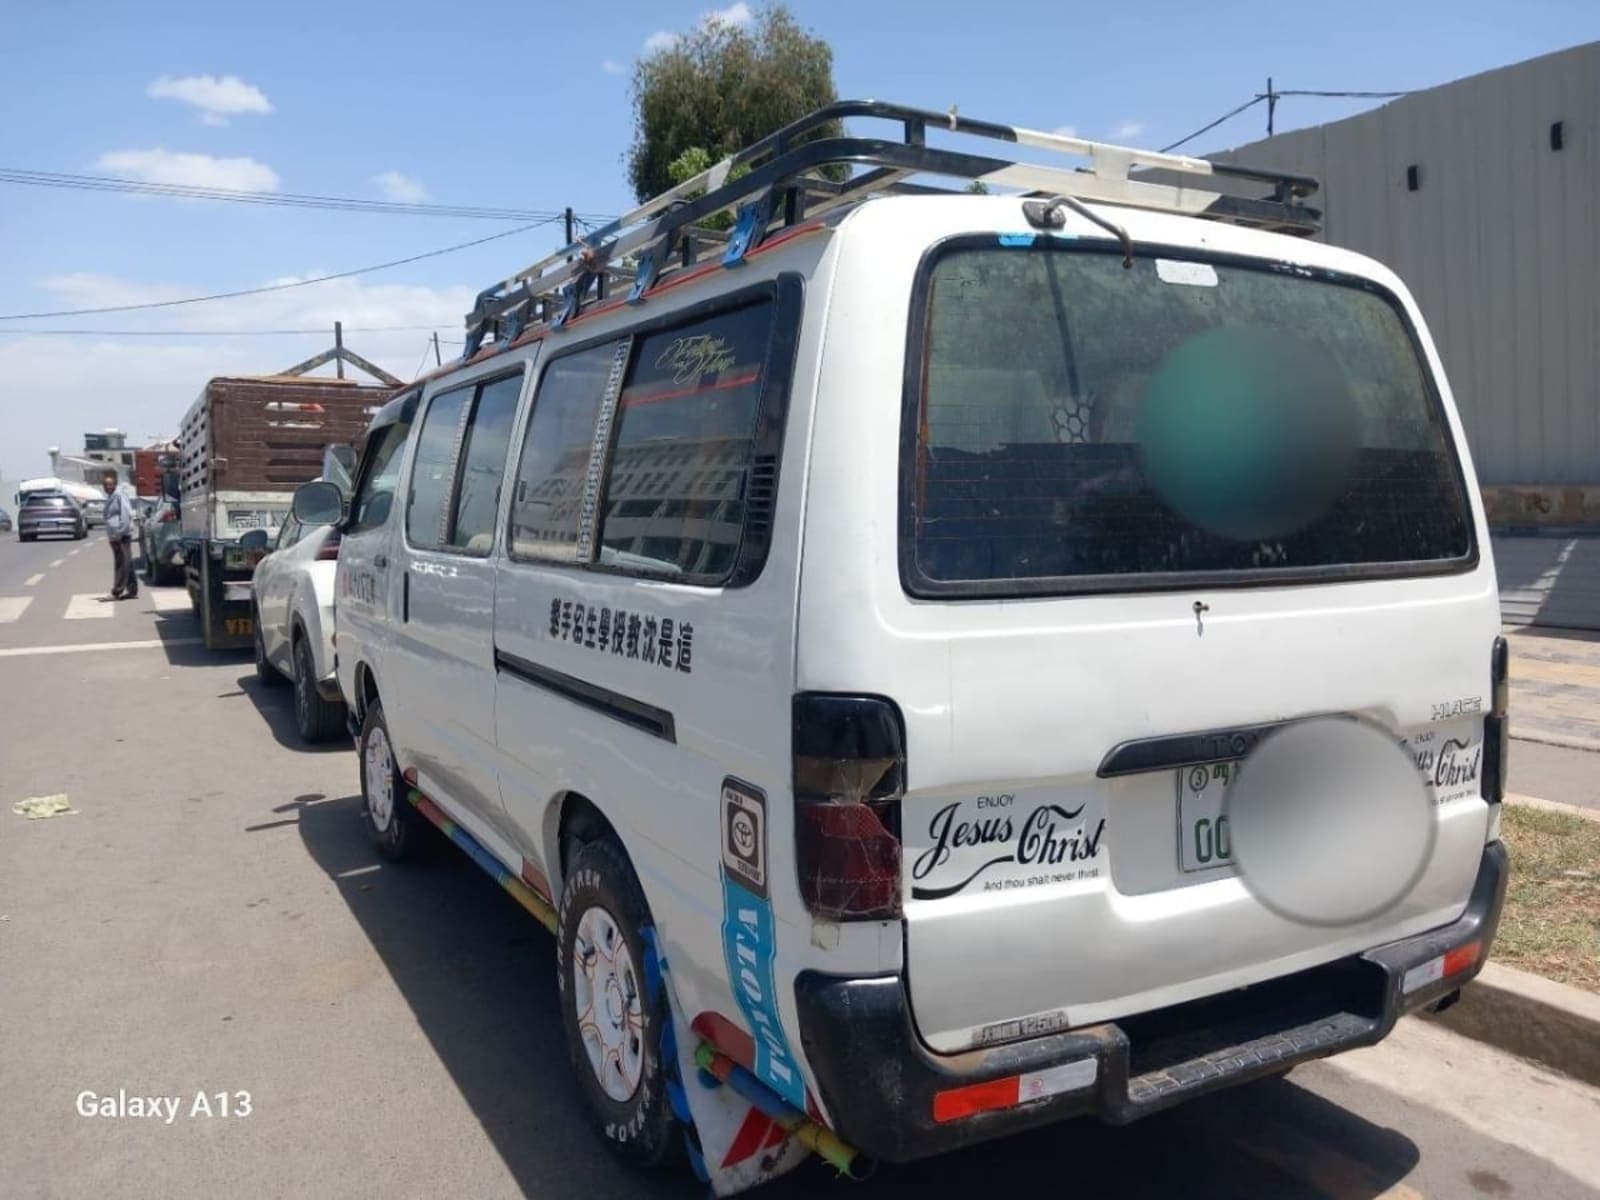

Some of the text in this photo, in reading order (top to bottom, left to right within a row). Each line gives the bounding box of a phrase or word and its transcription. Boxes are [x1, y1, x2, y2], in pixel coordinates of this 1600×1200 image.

[977, 794, 1015, 809] ENJOY
[912, 802, 1106, 880] Jesus Christ
[984, 879, 1003, 891] And
[1004, 877, 1025, 889] thou
[1050, 872, 1076, 883] never
